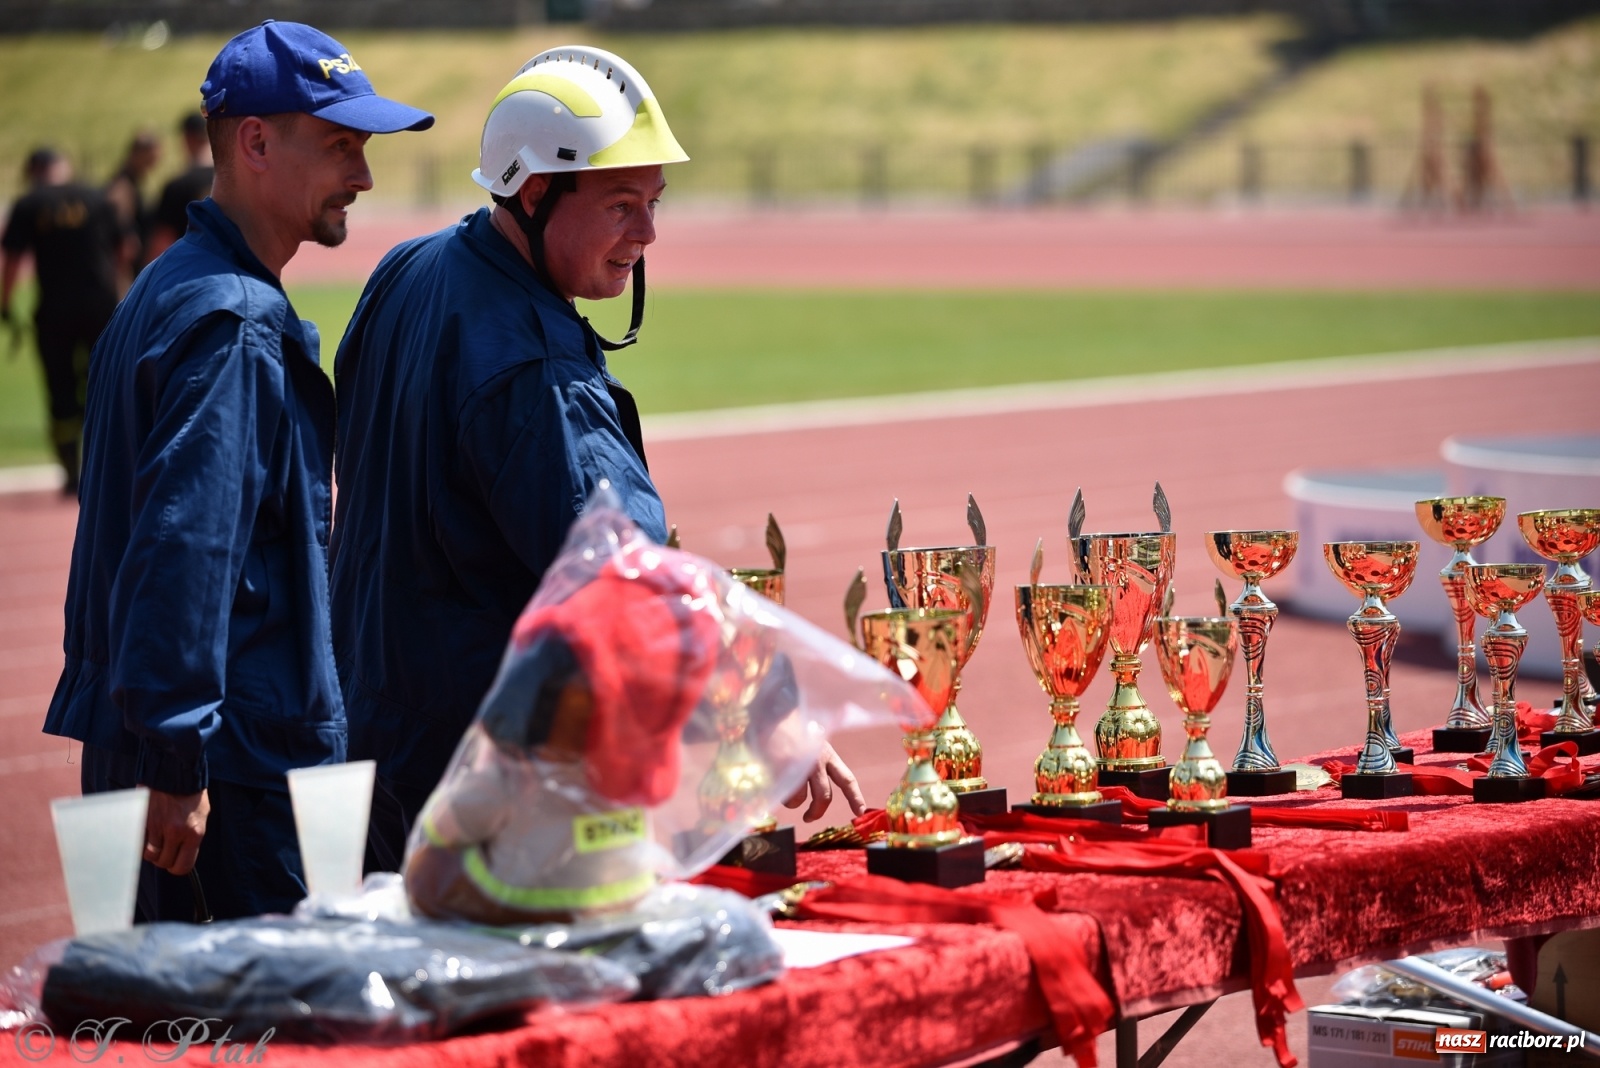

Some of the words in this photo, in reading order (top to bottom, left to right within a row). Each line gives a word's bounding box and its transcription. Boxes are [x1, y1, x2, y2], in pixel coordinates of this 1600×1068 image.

[1312, 1025, 1329, 1037] MS
[1330, 1027, 1345, 1039] 171
[1351, 1029, 1366, 1041] 181
[1372, 1031, 1387, 1043] 211
